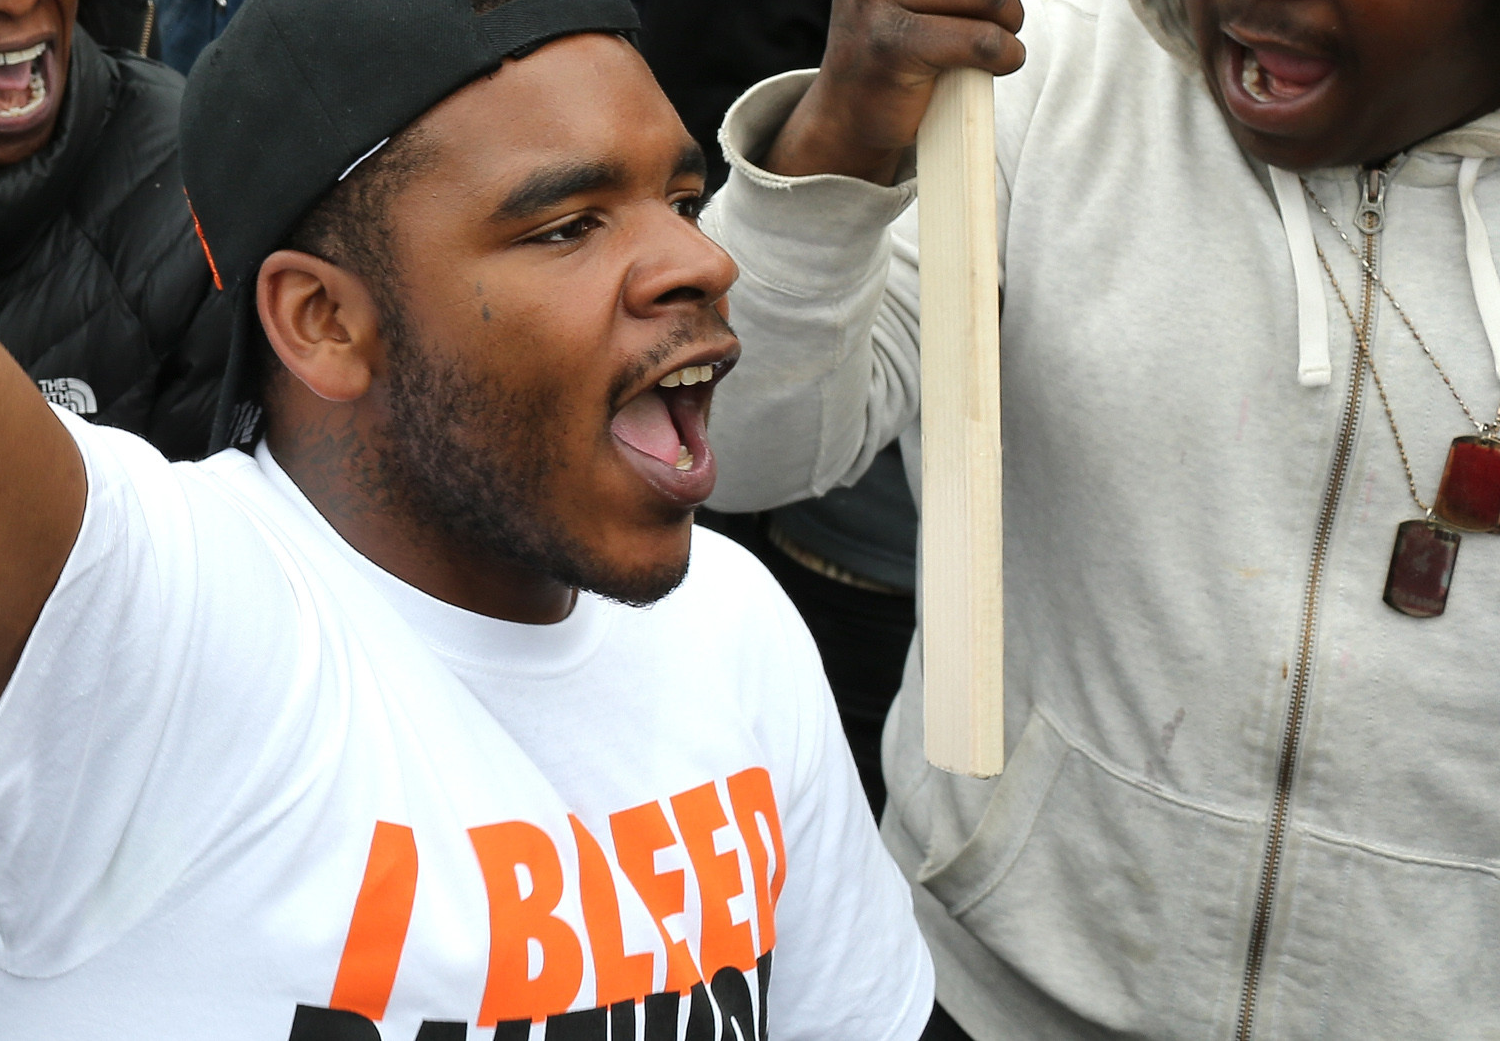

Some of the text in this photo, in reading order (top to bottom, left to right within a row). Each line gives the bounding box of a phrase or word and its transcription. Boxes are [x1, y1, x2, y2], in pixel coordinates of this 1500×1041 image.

[38, 378, 68, 392] THE
[329, 820, 418, 1022] I
[467, 766, 786, 1028] BLEED
